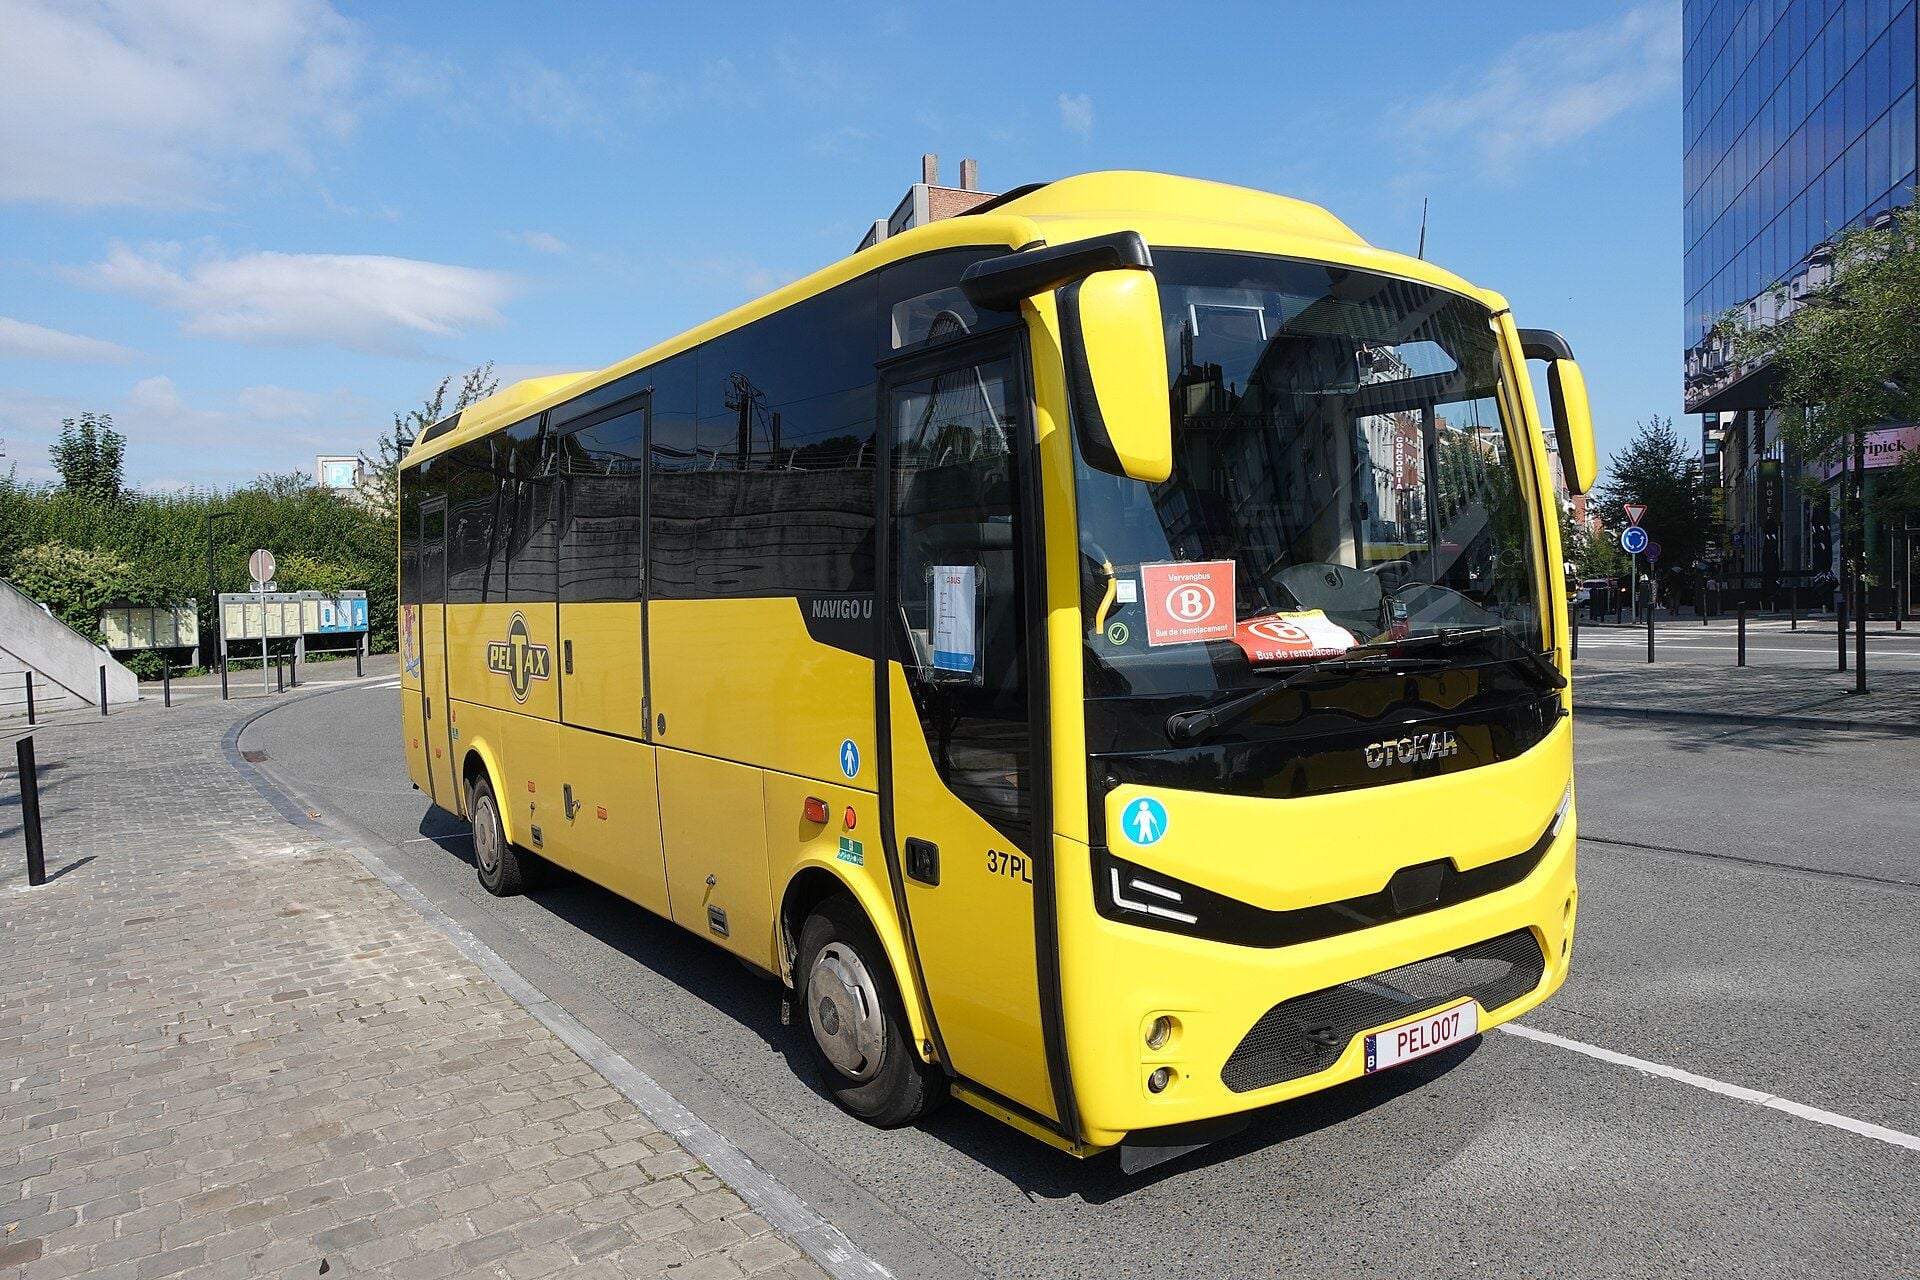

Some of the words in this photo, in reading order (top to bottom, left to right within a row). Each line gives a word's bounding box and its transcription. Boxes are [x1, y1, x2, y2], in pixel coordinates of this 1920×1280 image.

[1863, 439, 1907, 456] ripick
[1395, 436, 1403, 490] CONCORDIA
[1168, 572, 1211, 582] Vervangbus
[812, 599, 860, 619] NAVIGO
[863, 599, 873, 619] U
[1180, 589, 1203, 617] B
[1155, 629, 1168, 637] Bus
[1169, 627, 1178, 636] de
[1180, 623, 1228, 636] remplacement
[1256, 649, 1274, 660] Bus
[1275, 648, 1288, 659] de
[1289, 646, 1347, 659] remplaceme
[1364, 731, 1458, 769] OTOKAR
[987, 849, 1033, 884] 37PL
[1397, 1012, 1460, 1057] PEL007
[1367, 1055, 1375, 1068] B
